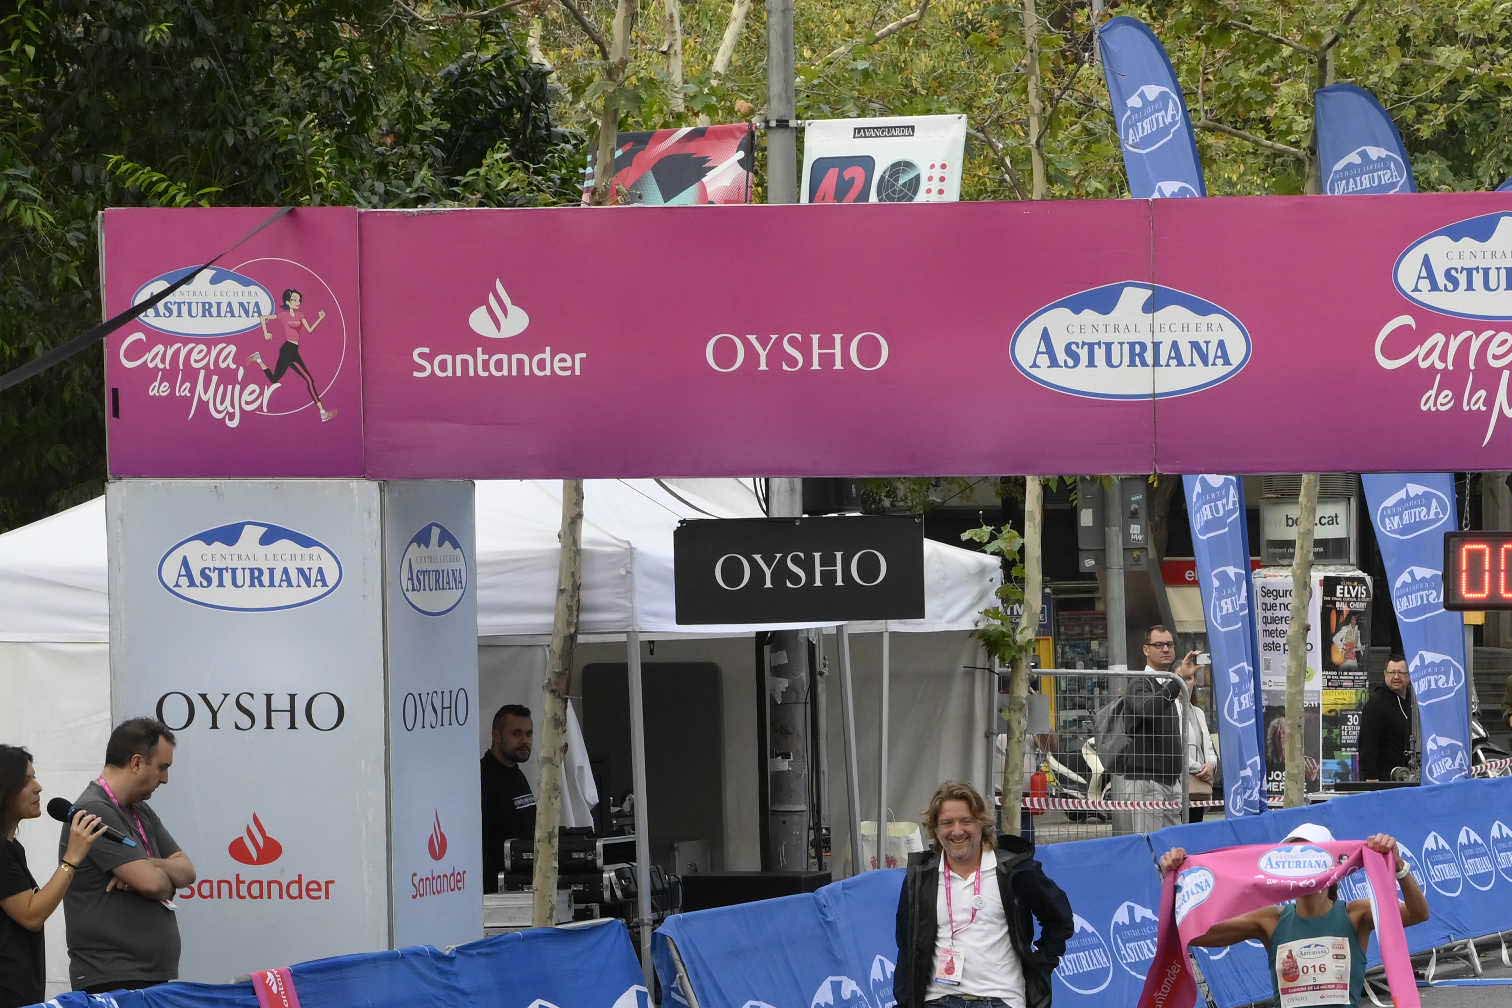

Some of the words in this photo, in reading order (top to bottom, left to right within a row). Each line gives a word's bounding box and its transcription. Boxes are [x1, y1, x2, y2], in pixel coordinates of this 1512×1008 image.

[865, 126, 913, 137] VANGUARDIA
[143, 291, 264, 319] ASTURIANA
[1066, 322, 1140, 334] CENTRAL
[1149, 321, 1225, 334] LECHERA
[119, 332, 238, 370] Carrera
[412, 346, 587, 378] Santander
[704, 331, 890, 374] OYSHO
[1028, 326, 1234, 369] ASTURIANA
[149, 371, 171, 397] de
[175, 371, 192, 397] la
[188, 366, 282, 429] Mujer
[1420, 373, 1455, 413] de
[1463, 371, 1488, 413] la
[172, 554, 330, 589] ASTURIANA
[200, 552, 259, 562] CENTRAL
[264, 551, 324, 562] LECHERA
[713, 548, 888, 591] OYSHO
[405, 557, 465, 593] ASTURIANA
[1262, 602, 1278, 612] que
[1336, 585, 1367, 598] ELVIS
[1262, 613, 1295, 625] quiere
[1262, 628, 1288, 639] mete
[1263, 641, 1282, 652] este
[155, 690, 346, 732] OYSHO
[402, 686, 470, 733] OYSHO
[1263, 857, 1329, 870] ASTURIANA
[410, 868, 467, 901] Santander
